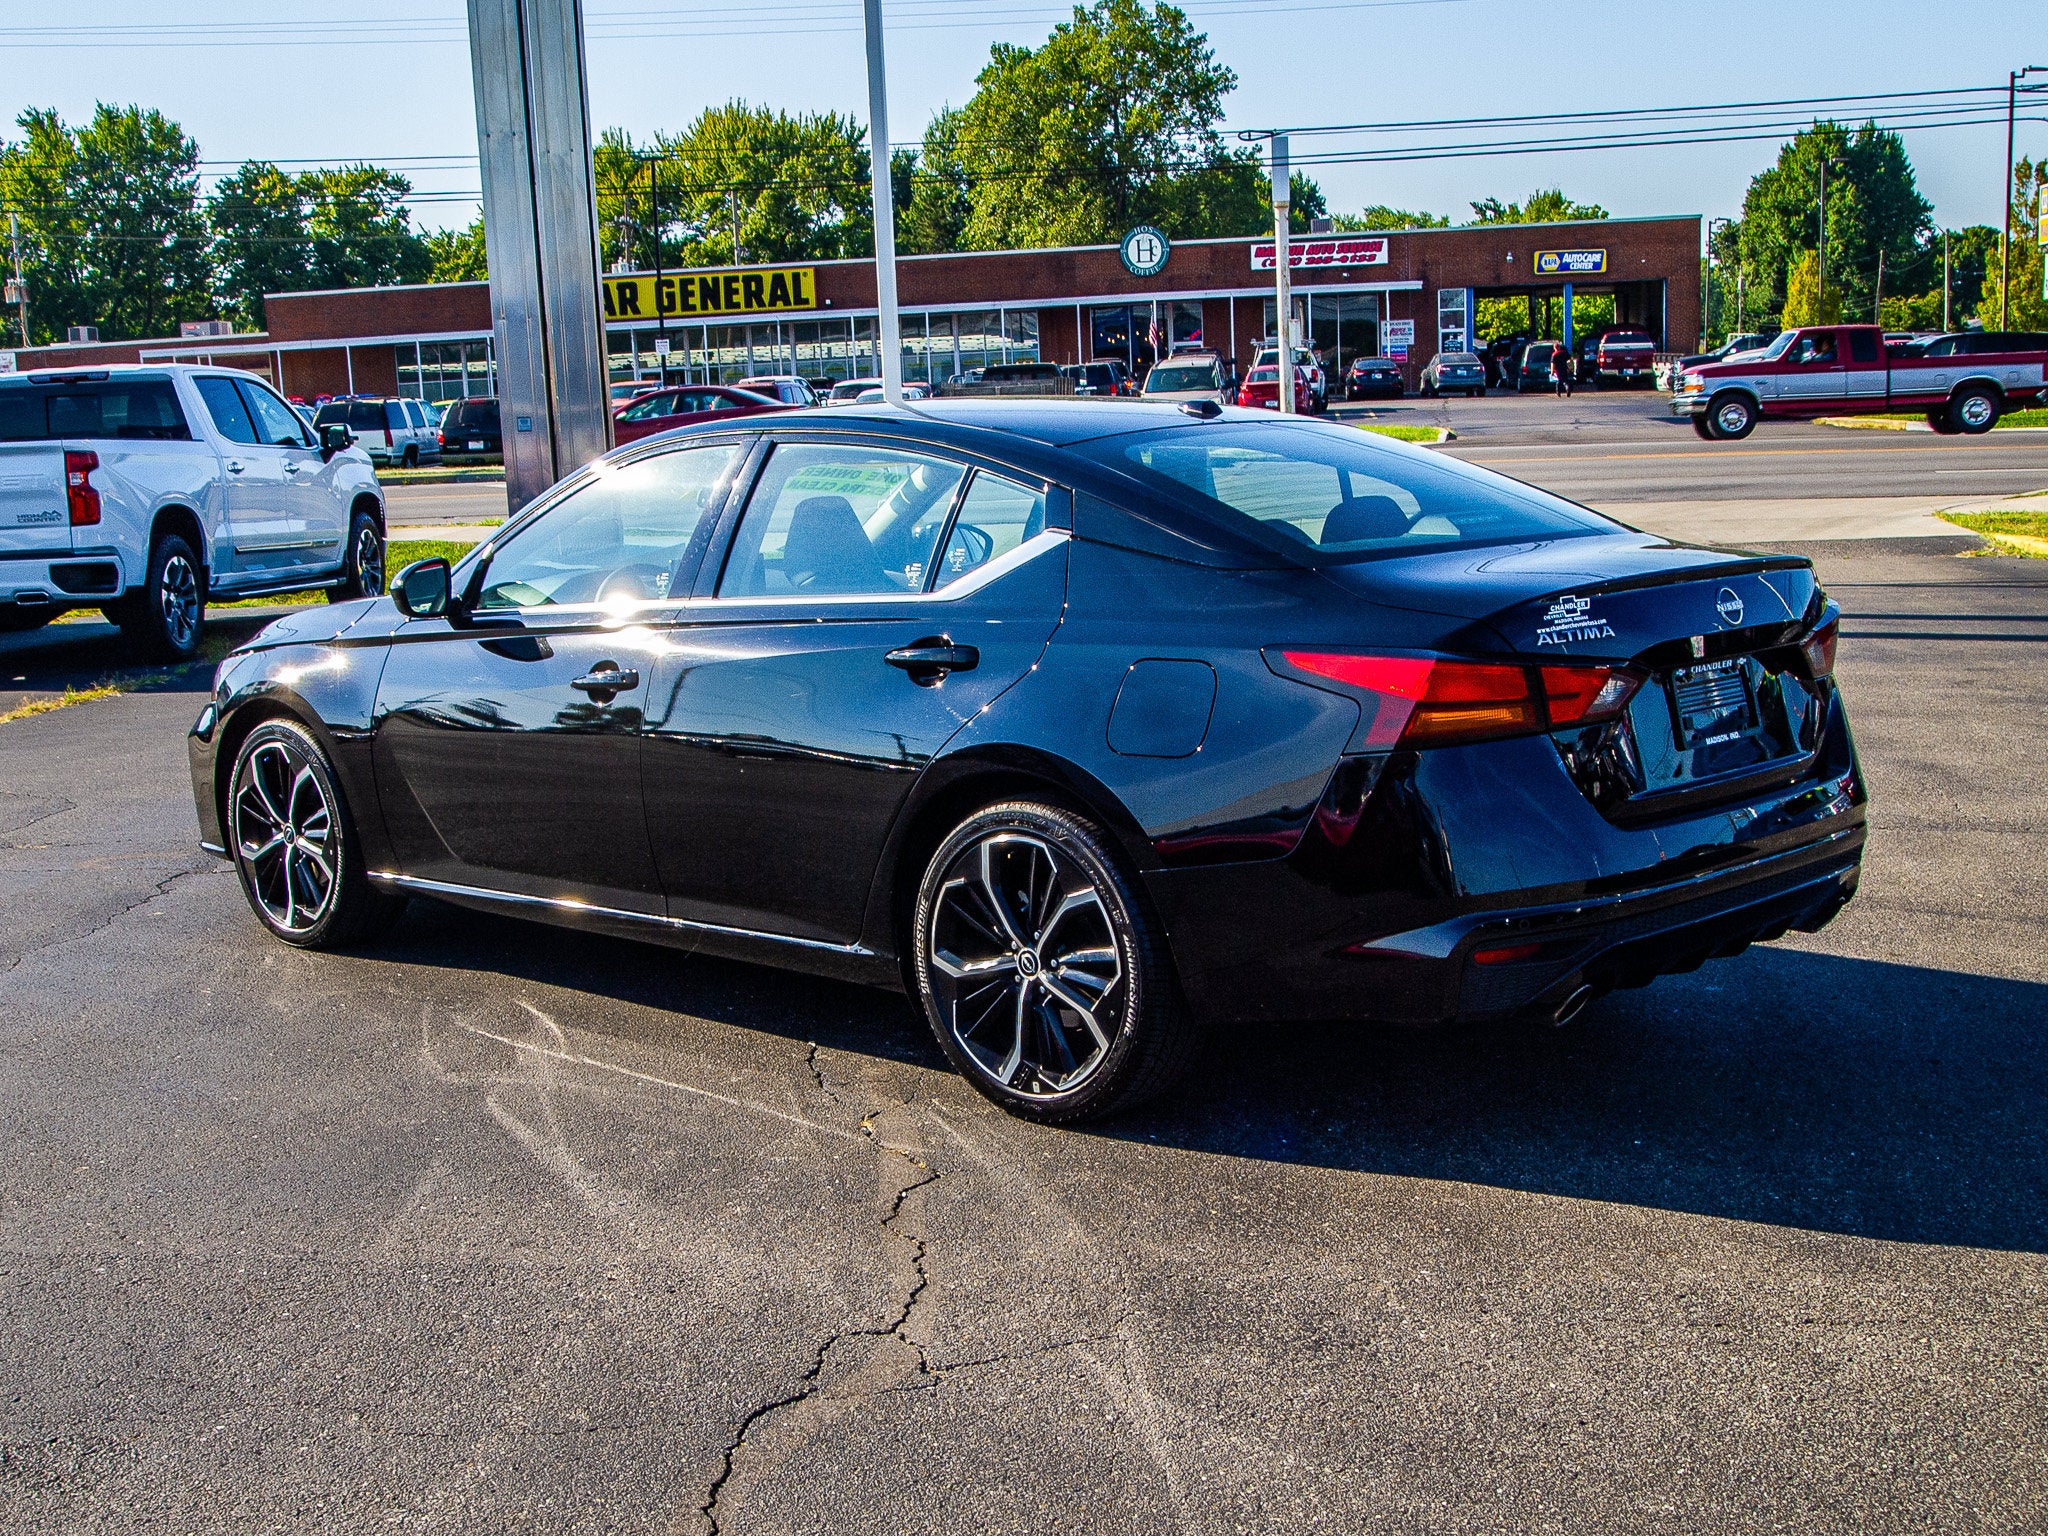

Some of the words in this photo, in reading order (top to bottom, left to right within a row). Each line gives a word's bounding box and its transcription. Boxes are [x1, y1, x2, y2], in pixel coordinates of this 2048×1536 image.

[1134, 225, 1154, 234] HOS
[1255, 245, 1305, 258] MAON
[1306, 243, 1336, 256] AUTO
[1336, 241, 1384, 254] SERVICE
[1550, 602, 1586, 612] CHANDLER
[1537, 626, 1616, 646] ALTIMA
[1691, 660, 1732, 673] CHANDLER
